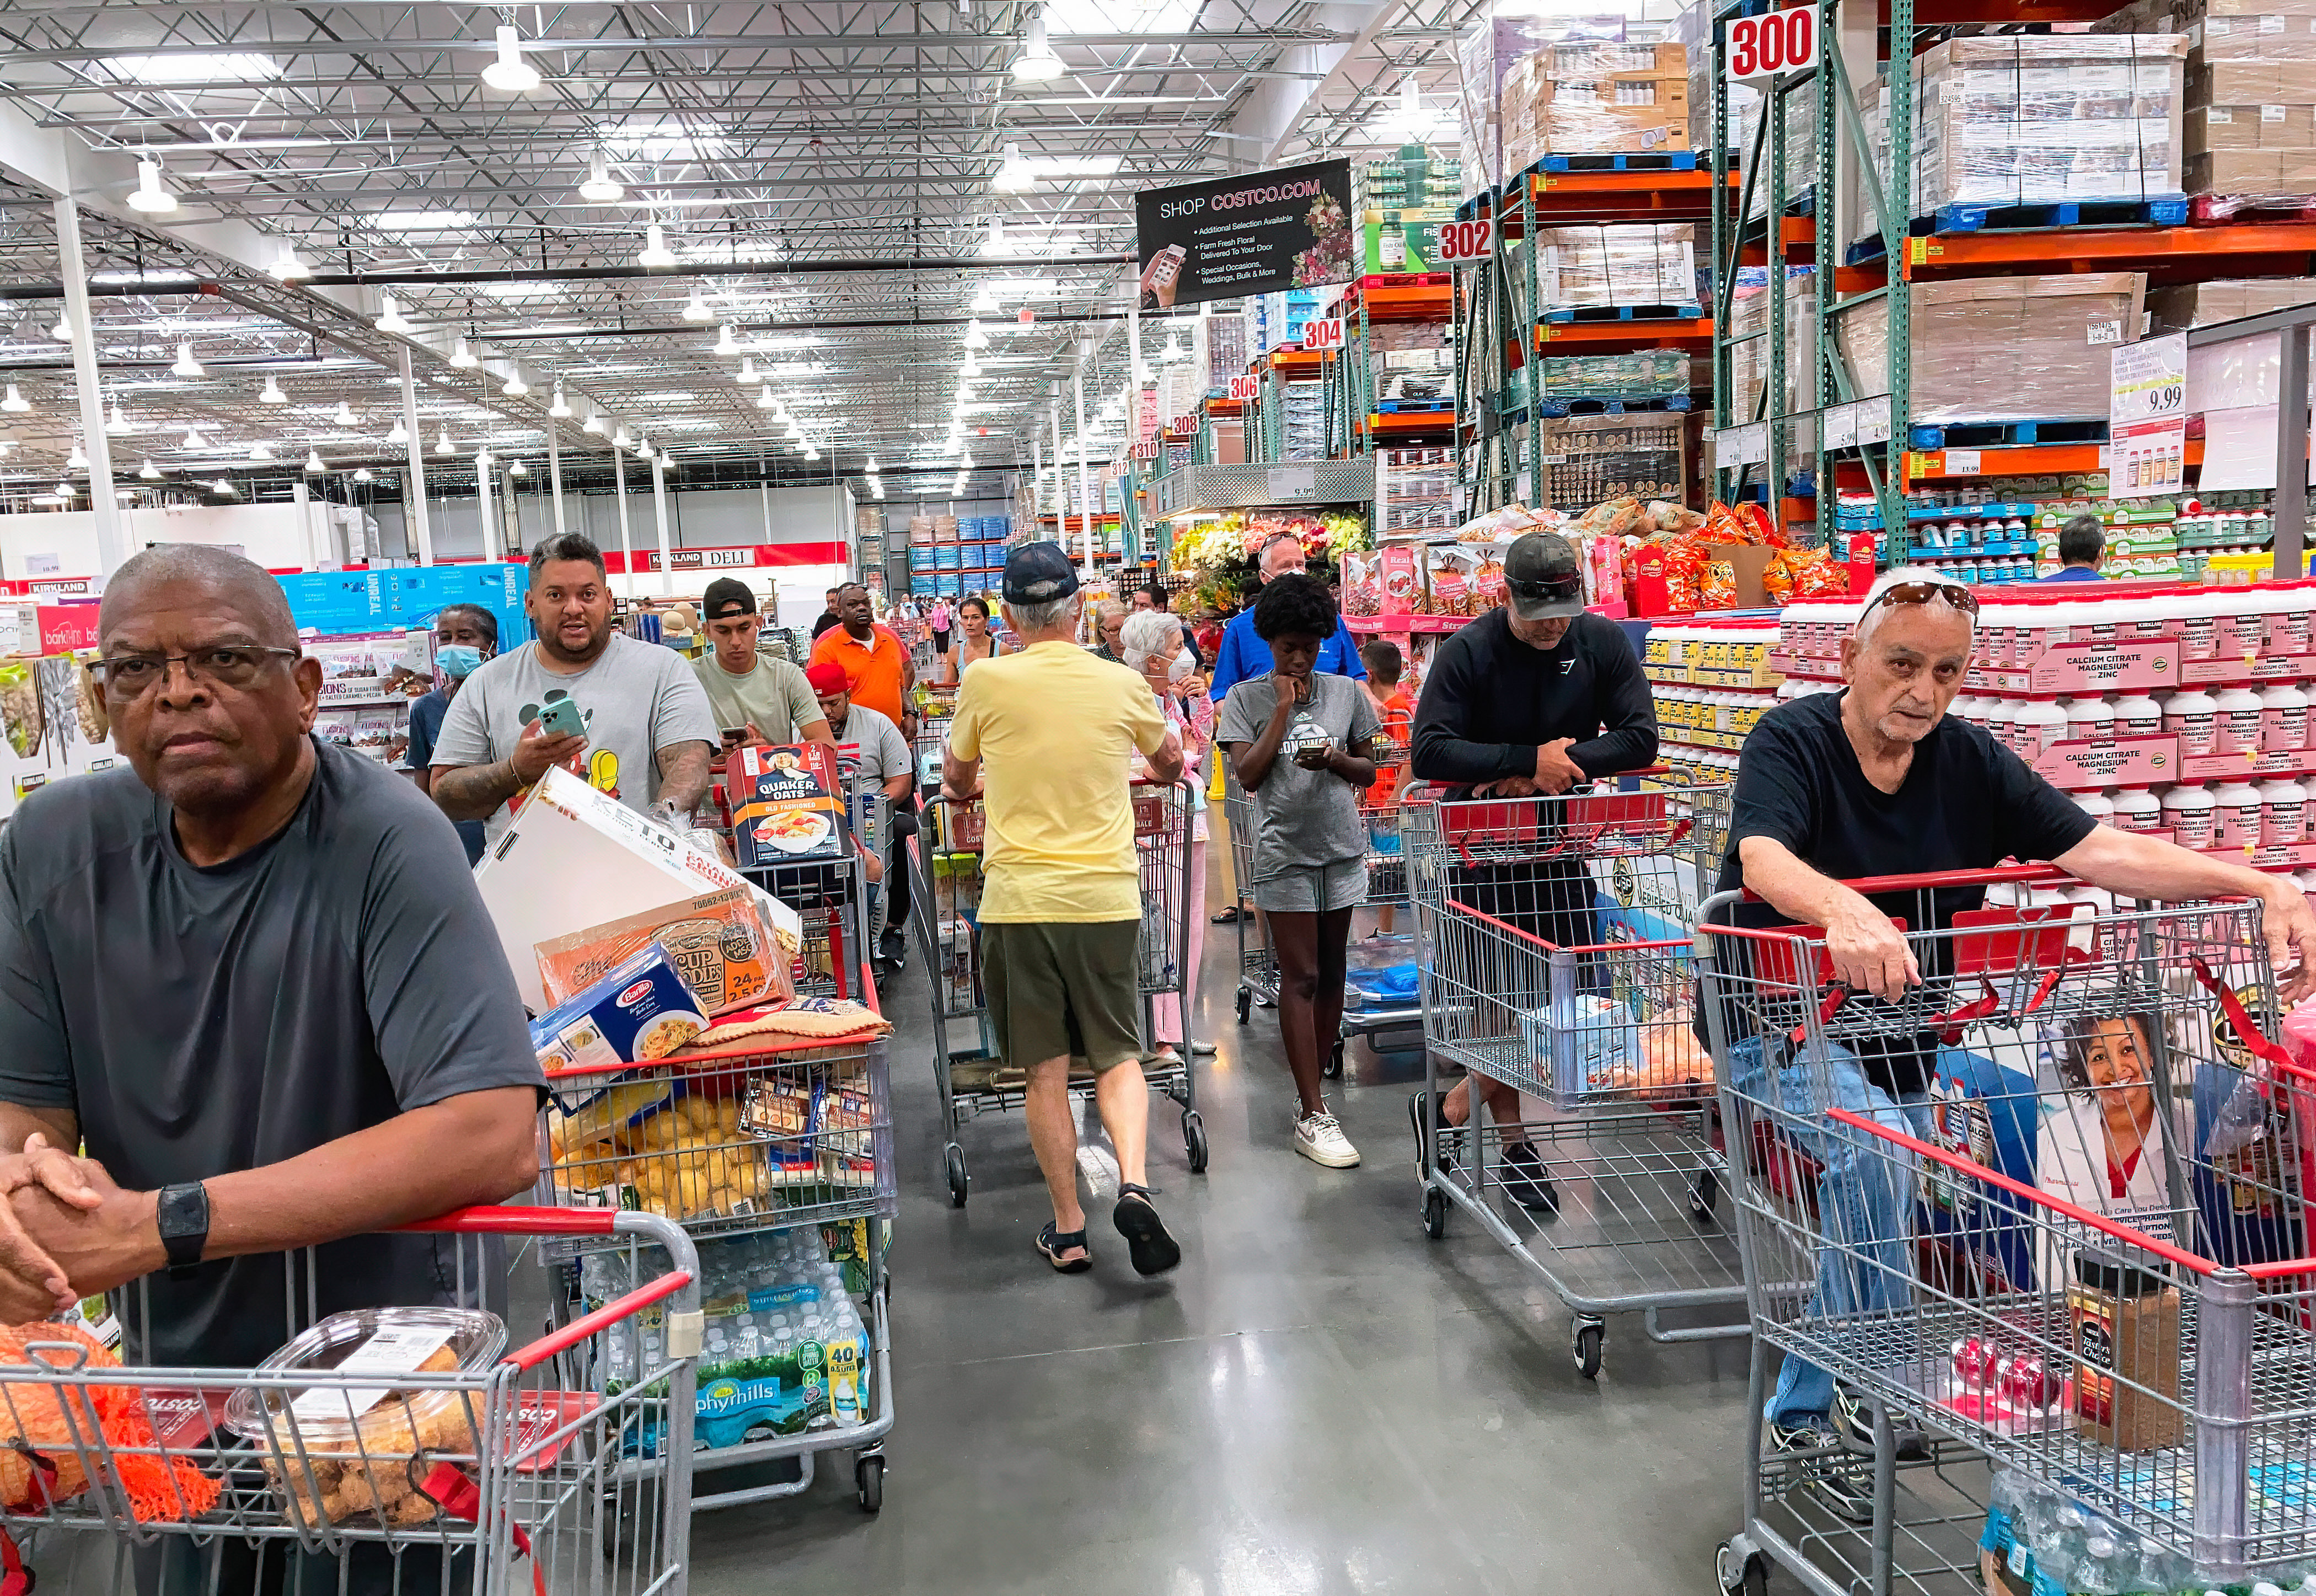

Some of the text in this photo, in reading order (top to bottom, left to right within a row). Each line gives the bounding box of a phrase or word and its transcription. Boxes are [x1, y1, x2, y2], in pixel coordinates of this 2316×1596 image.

[1733, 10, 1812, 75] 300
[1161, 179, 1320, 218] SHOP COSTCO.COM
[1199, 215, 1293, 235] Additional Selection Available
[1200, 236, 1255, 250] Farm Fresh Floral
[1441, 221, 1491, 259] 302
[1201, 244, 1273, 260] Delivered To Your Door
[1201, 261, 1262, 275] Special Occasions,
[1202, 275, 1235, 284] Weddings,
[1237, 271, 1251, 280] Bulk
[1306, 320, 1342, 347] 304
[1231, 376, 1258, 398] 306
[2150, 386, 2181, 412] 9.99
[1174, 416, 1197, 433] 308
[1138, 443, 1156, 458] 310
[1112, 462, 1128, 475] 312
[1294, 488, 1314, 496] 9.99
[652, 551, 744, 564] KKLAND DELI
[33, 583, 85, 593] KIRKLAND
[367, 574, 381, 615] UNREAL
[503, 566, 517, 608] UNREAL
[2066, 656, 2104, 665] CALCIUM
[2078, 662, 2129, 671] MAGNESIUM
[2098, 671, 2117, 679] ZINC
[319, 683, 346, 694] SIONS
[2066, 751, 2140, 761] CALCIUM CITRATE
[2077, 759, 2128, 768] MAGNESIUM
[774, 790, 806, 800] OATS
[780, 802, 816, 811] FASHIONED
[593, 795, 675, 851] KETO
[1616, 876, 1631, 891] USP
[725, 939, 750, 954] ADDE
[674, 950, 713, 967] CUP
[685, 964, 722, 985] ODLES
[733, 973, 752, 988] 24
[625, 982, 650, 1002] Barilla
[729, 988, 750, 1003] 2.5
[2083, 1335, 2110, 1354] Tastr's
[832, 1347, 854, 1363] 40
[2083, 1347, 2110, 1364] Choce
[695, 1383, 774, 1413] phyrhills
